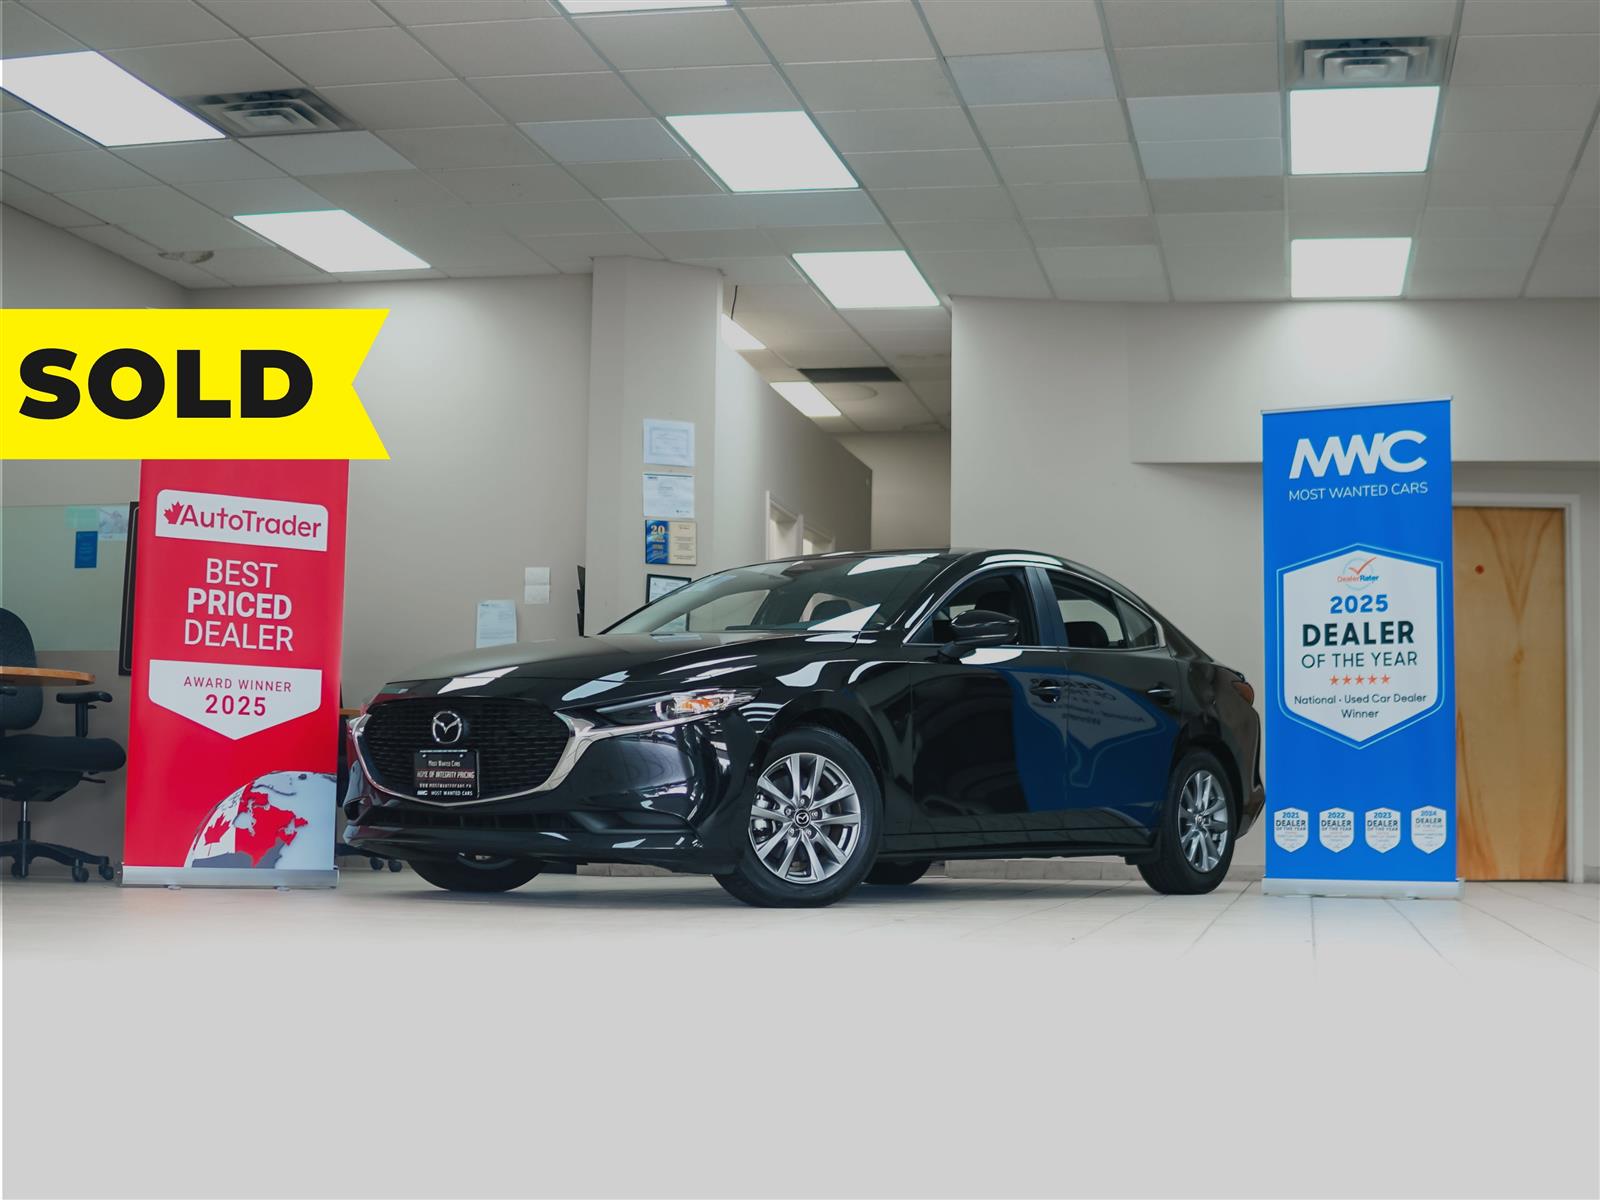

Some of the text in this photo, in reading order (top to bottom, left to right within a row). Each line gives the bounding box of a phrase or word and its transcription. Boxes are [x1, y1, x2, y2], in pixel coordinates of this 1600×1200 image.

[1289, 430, 1428, 479] MWC
[1289, 482, 1428, 501] MOST WANTED CARS
[180, 504, 322, 539] AutoTrader
[205, 557, 278, 588] BEST
[187, 587, 292, 620] PRICED
[1329, 594, 1389, 614] 2025
[184, 618, 294, 651] DEALER
[1302, 620, 1415, 647] DEALER
[1301, 651, 1418, 669] OF THE YEAR
[183, 675, 292, 693] AWARD WINNER
[205, 693, 267, 716] 2025
[1294, 692, 1427, 705] National Used Car Dealer
[1341, 709, 1380, 719] Winner
[1275, 819, 1306, 827] DEALER
[1321, 819, 1352, 827] DEALER
[1367, 819, 1398, 827] DEALER
